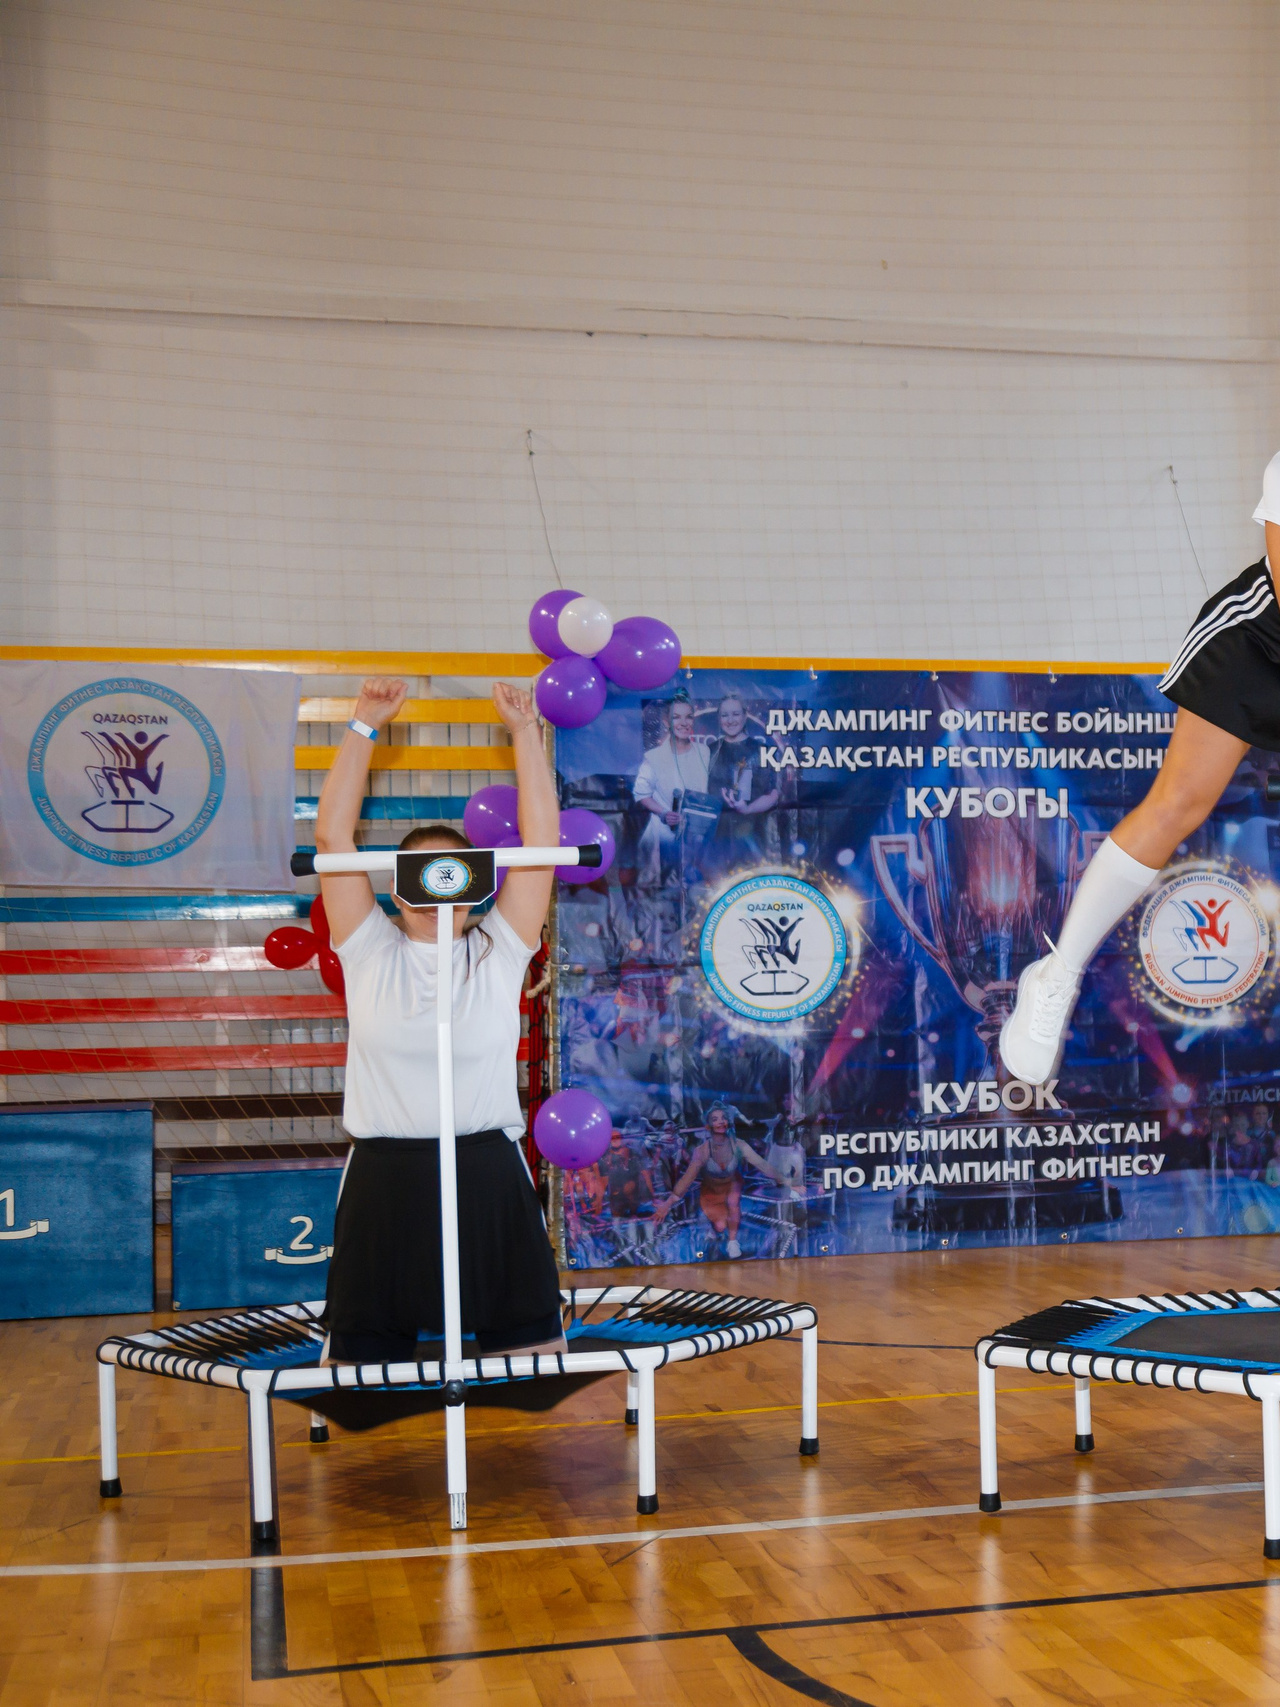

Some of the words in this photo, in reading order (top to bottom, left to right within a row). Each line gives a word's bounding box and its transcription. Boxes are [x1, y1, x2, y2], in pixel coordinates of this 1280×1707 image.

[32, 711, 61, 773] ДЖАМПИНГ
[60, 684, 103, 712] ФИТНЕС
[172, 697, 224, 776] РЕСПУБЛИКАСЫ
[93, 712, 168, 725] QAZAQSTAN
[766, 709, 933, 735] ДЖАМПИНГ
[939, 708, 1049, 732] ФИТНЕС
[1056, 707, 1178, 733] БОЙЫНШ
[760, 746, 924, 772] ҚАЗАҚСТАН
[932, 746, 1168, 769] РЕСПУБЛИКАСЫН
[906, 786, 1069, 819] КУБОГЫ
[37, 796, 68, 837] JUMPING
[67, 834, 108, 860] FITNESS
[110, 849, 163, 863] REPUBLIC
[164, 843, 178, 854] OF
[704, 902, 726, 951] ДЖАМПИНГ
[726, 882, 758, 904] ФИТНЕС
[808, 891, 843, 952] РЕСПУБЛИКАСЫ
[747, 903, 803, 912] QAZAQSTAN
[1142, 890, 1169, 938] ФЕДЕРАЦИЯ
[1168, 875, 1216, 893] ДЖАМПИНГ
[1217, 878, 1250, 904] ФИТНЕСА
[708, 972, 733, 1003] JUMPING
[732, 997, 761, 1018] FITNESS
[762, 1008, 798, 1019] REPUBLIC
[799, 1003, 810, 1013] OF
[809, 962, 842, 1006] KAZAKHSTAN
[1144, 953, 1165, 987] RUSSIAN
[1165, 984, 1198, 1004] JUMPING
[1201, 992, 1234, 1005] FITNESS
[1235, 951, 1266, 994] FEDERATION
[923, 1079, 1062, 1114] КУБОК
[820, 1127, 998, 1156] РЕСПУБЛИКИ
[1006, 1121, 1161, 1148] КАЗАХСТАН
[823, 1166, 866, 1190] ПО
[872, 1159, 1035, 1191] ДЖАМПИНГ
[1041, 1153, 1166, 1181] ФИТНЕСУ
[0, 1188, 15, 1228] 1
[289, 1215, 314, 1250] 2
